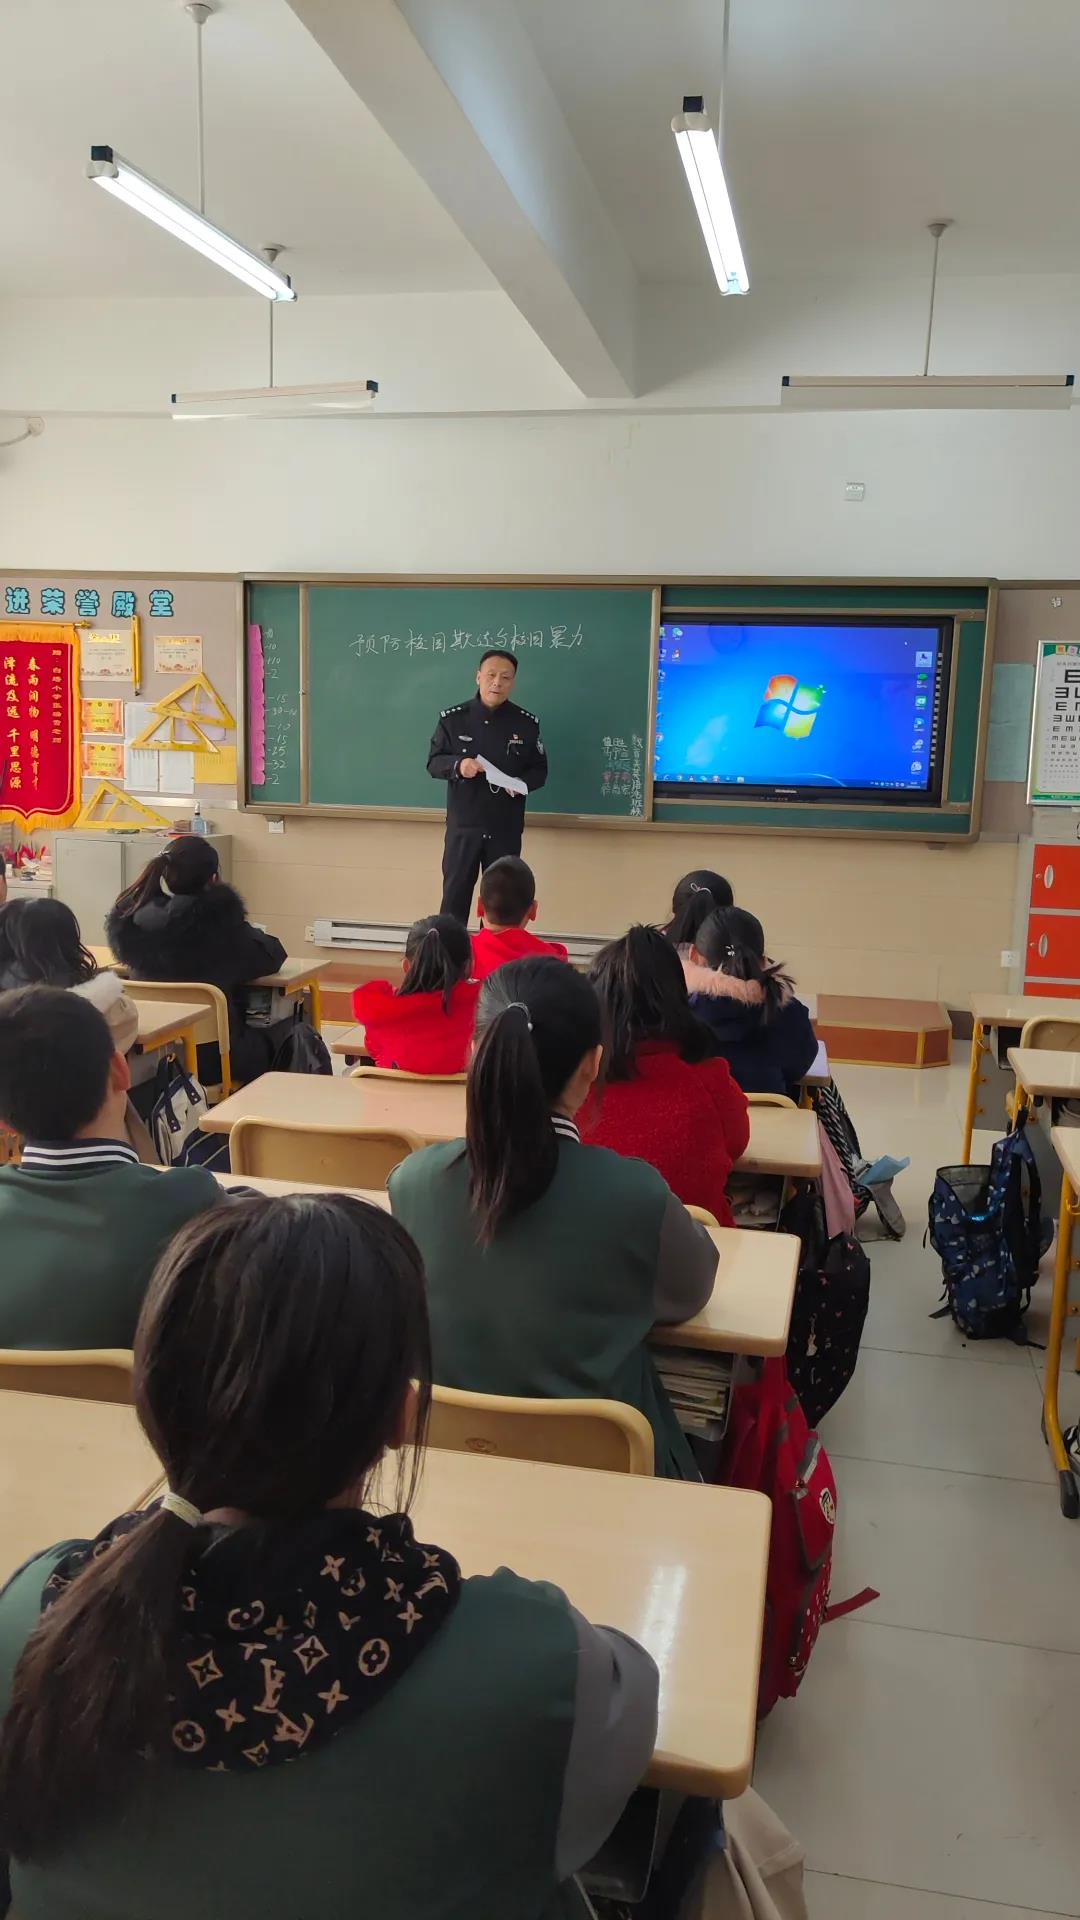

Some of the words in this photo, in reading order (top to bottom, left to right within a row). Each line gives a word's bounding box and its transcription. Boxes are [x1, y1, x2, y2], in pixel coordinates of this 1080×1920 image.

[5, 586, 174, 618] 进荣誉殿堂
[266, 773, 280, 785] -2
